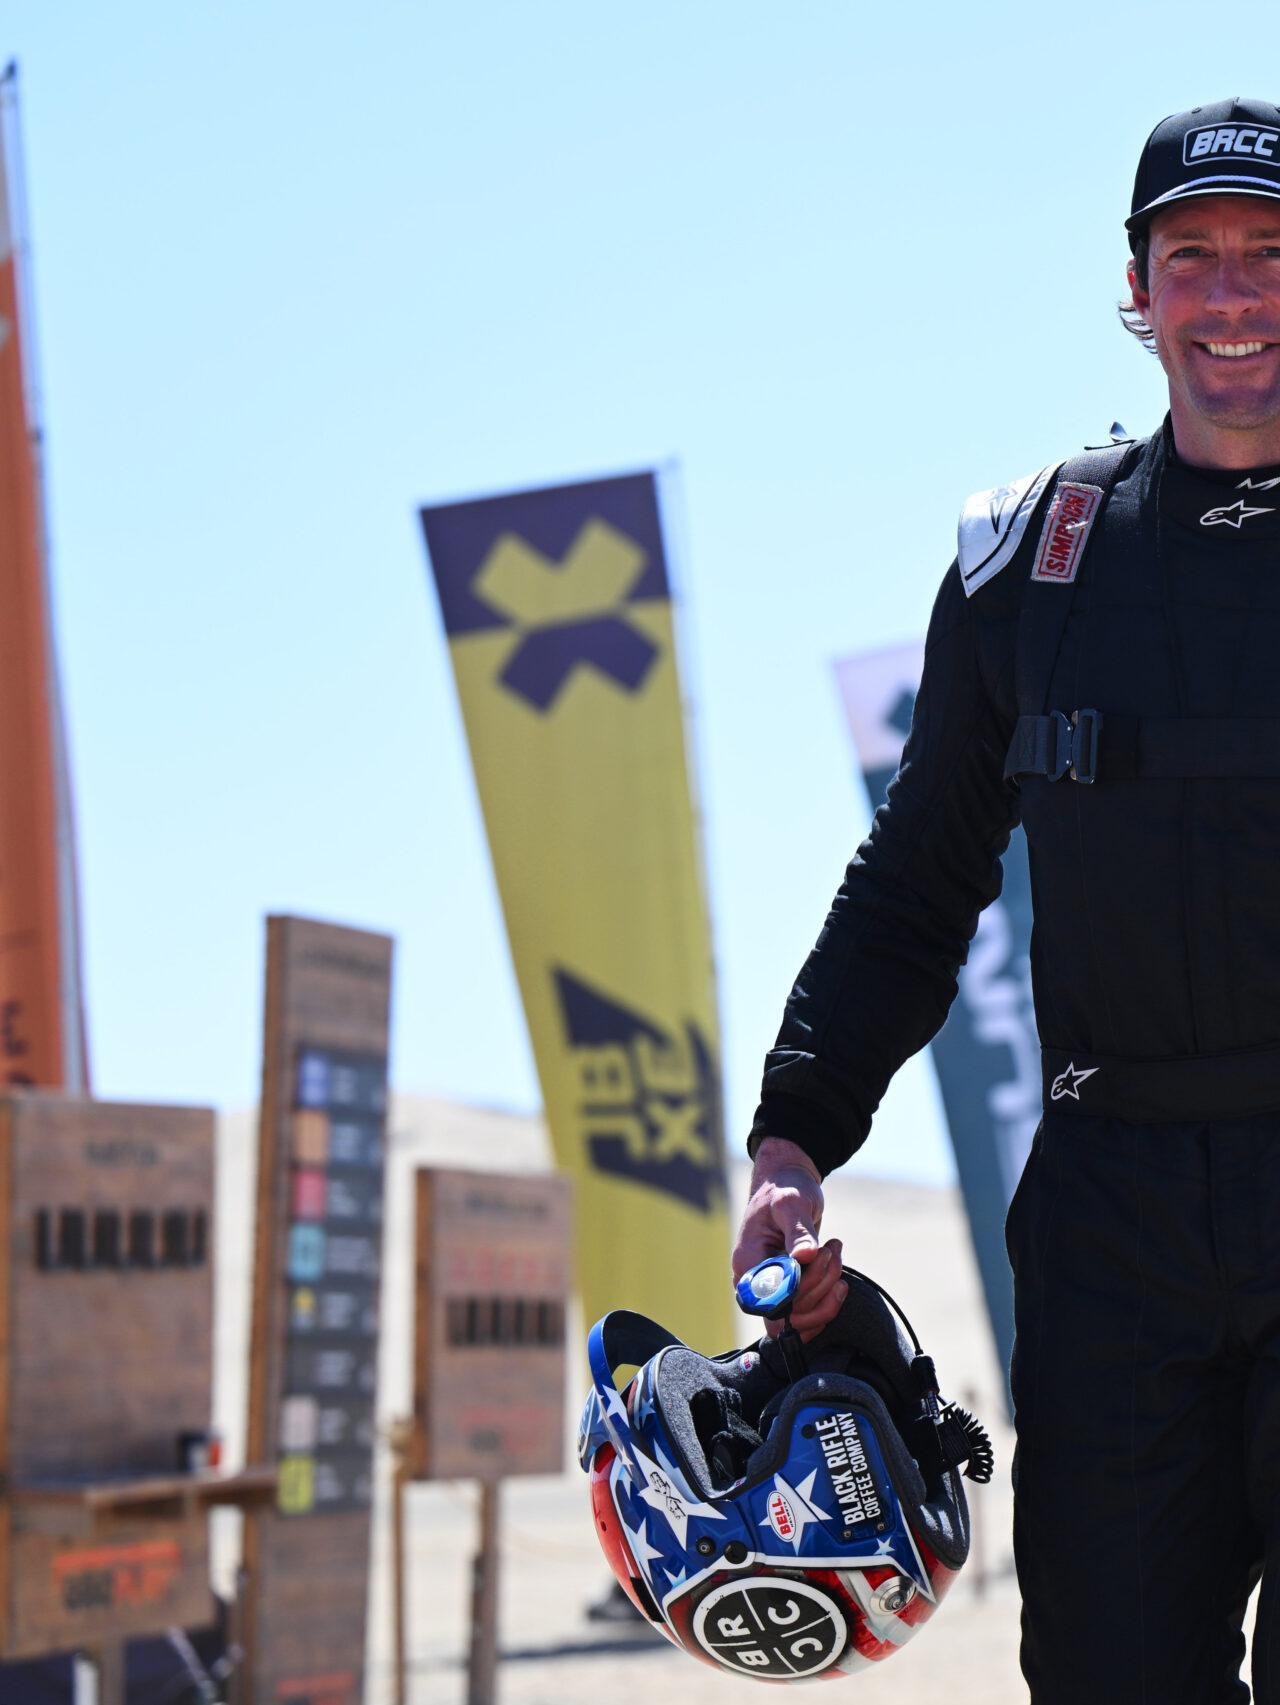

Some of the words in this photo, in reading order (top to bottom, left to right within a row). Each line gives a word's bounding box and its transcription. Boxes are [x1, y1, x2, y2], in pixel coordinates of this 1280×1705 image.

[1190, 128, 1279, 158] BRCC
[1046, 492, 1088, 573] SIMPSON
[815, 1415, 849, 1469] RIFLE
[836, 1412, 868, 1473] COMPANY
[772, 1497, 792, 1535] BELL
[831, 1469, 866, 1526] BLACK
[855, 1473, 881, 1519] COFFEE
